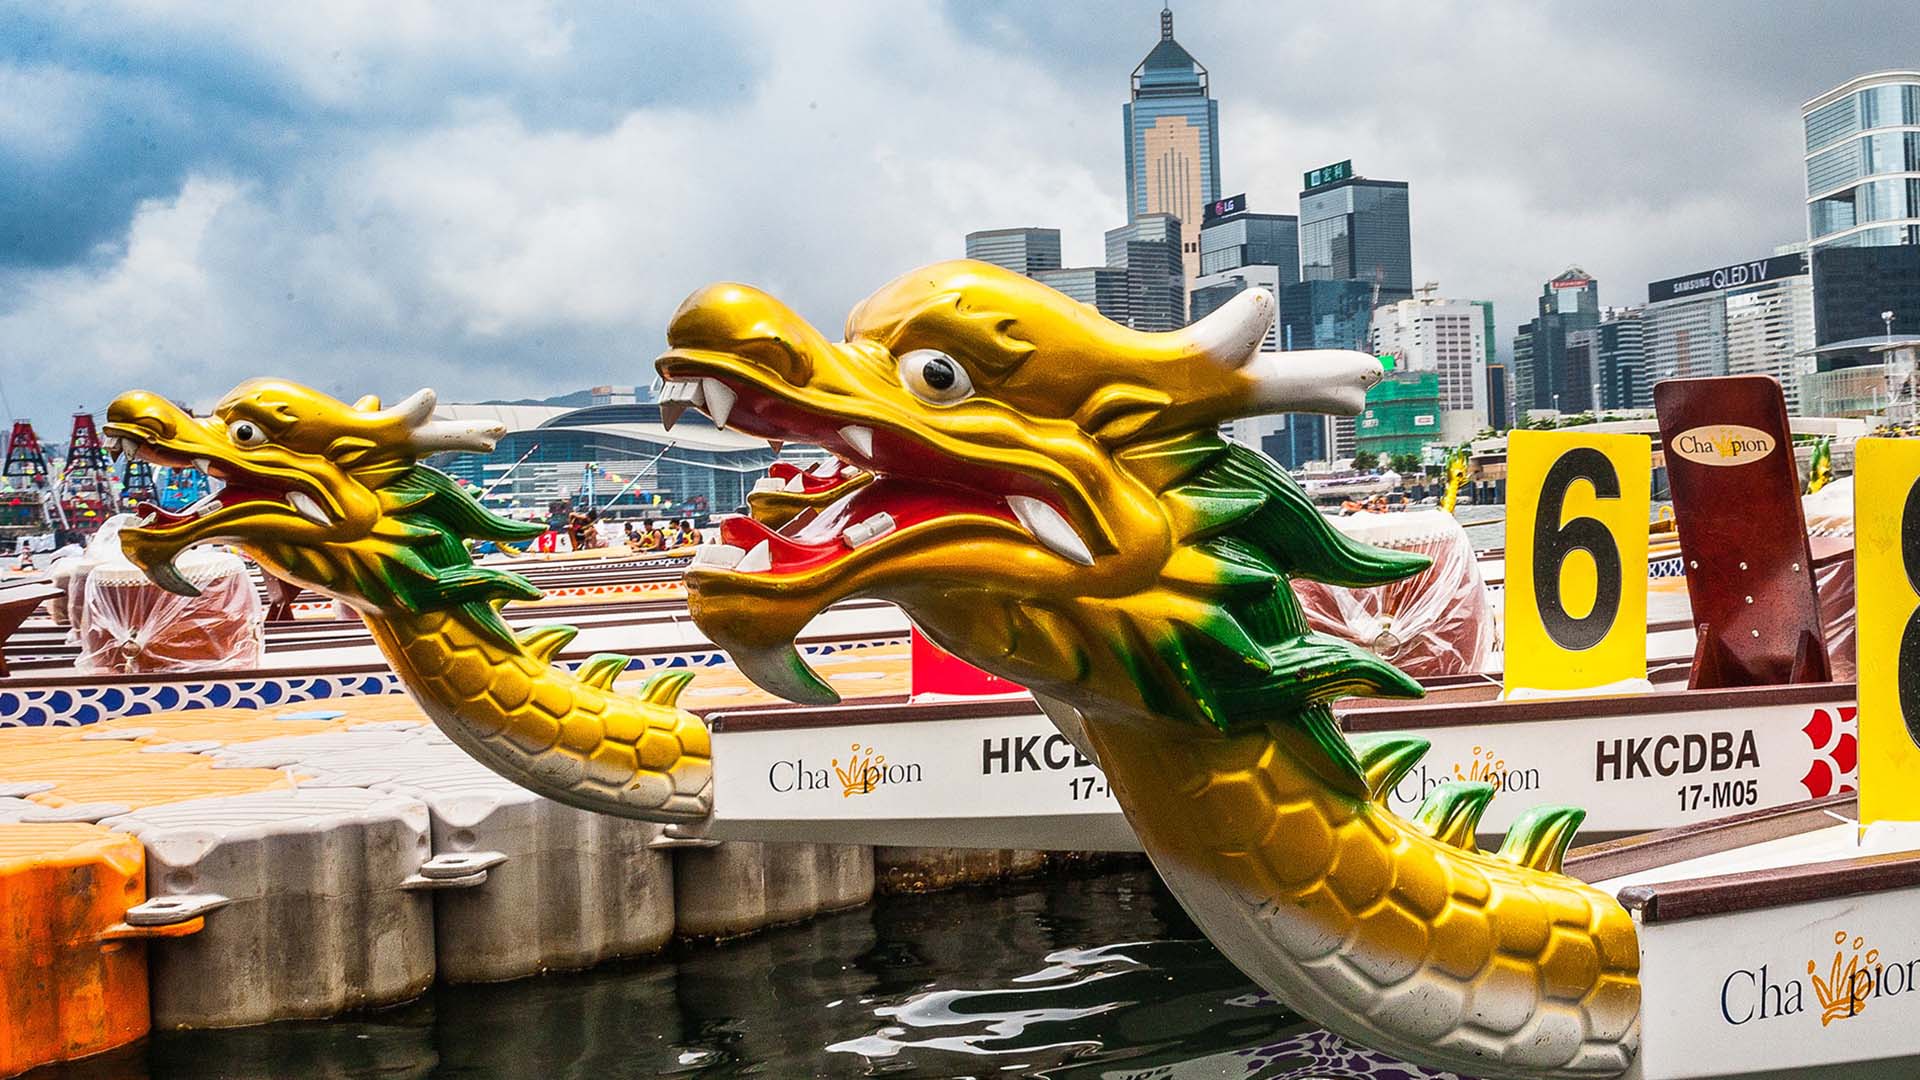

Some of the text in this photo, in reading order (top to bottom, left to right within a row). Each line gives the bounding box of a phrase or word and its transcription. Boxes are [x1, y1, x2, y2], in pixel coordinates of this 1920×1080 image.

[1224, 200, 1234, 212] LG
[1673, 260, 1768, 293] SAMSUNG QLED TV
[543, 533, 553, 548] 3
[1532, 447, 1622, 651] 6
[1596, 730, 1760, 782] HKCDBA
[1069, 777, 1111, 800] 17-
[1677, 779, 1758, 811] 17-M05
